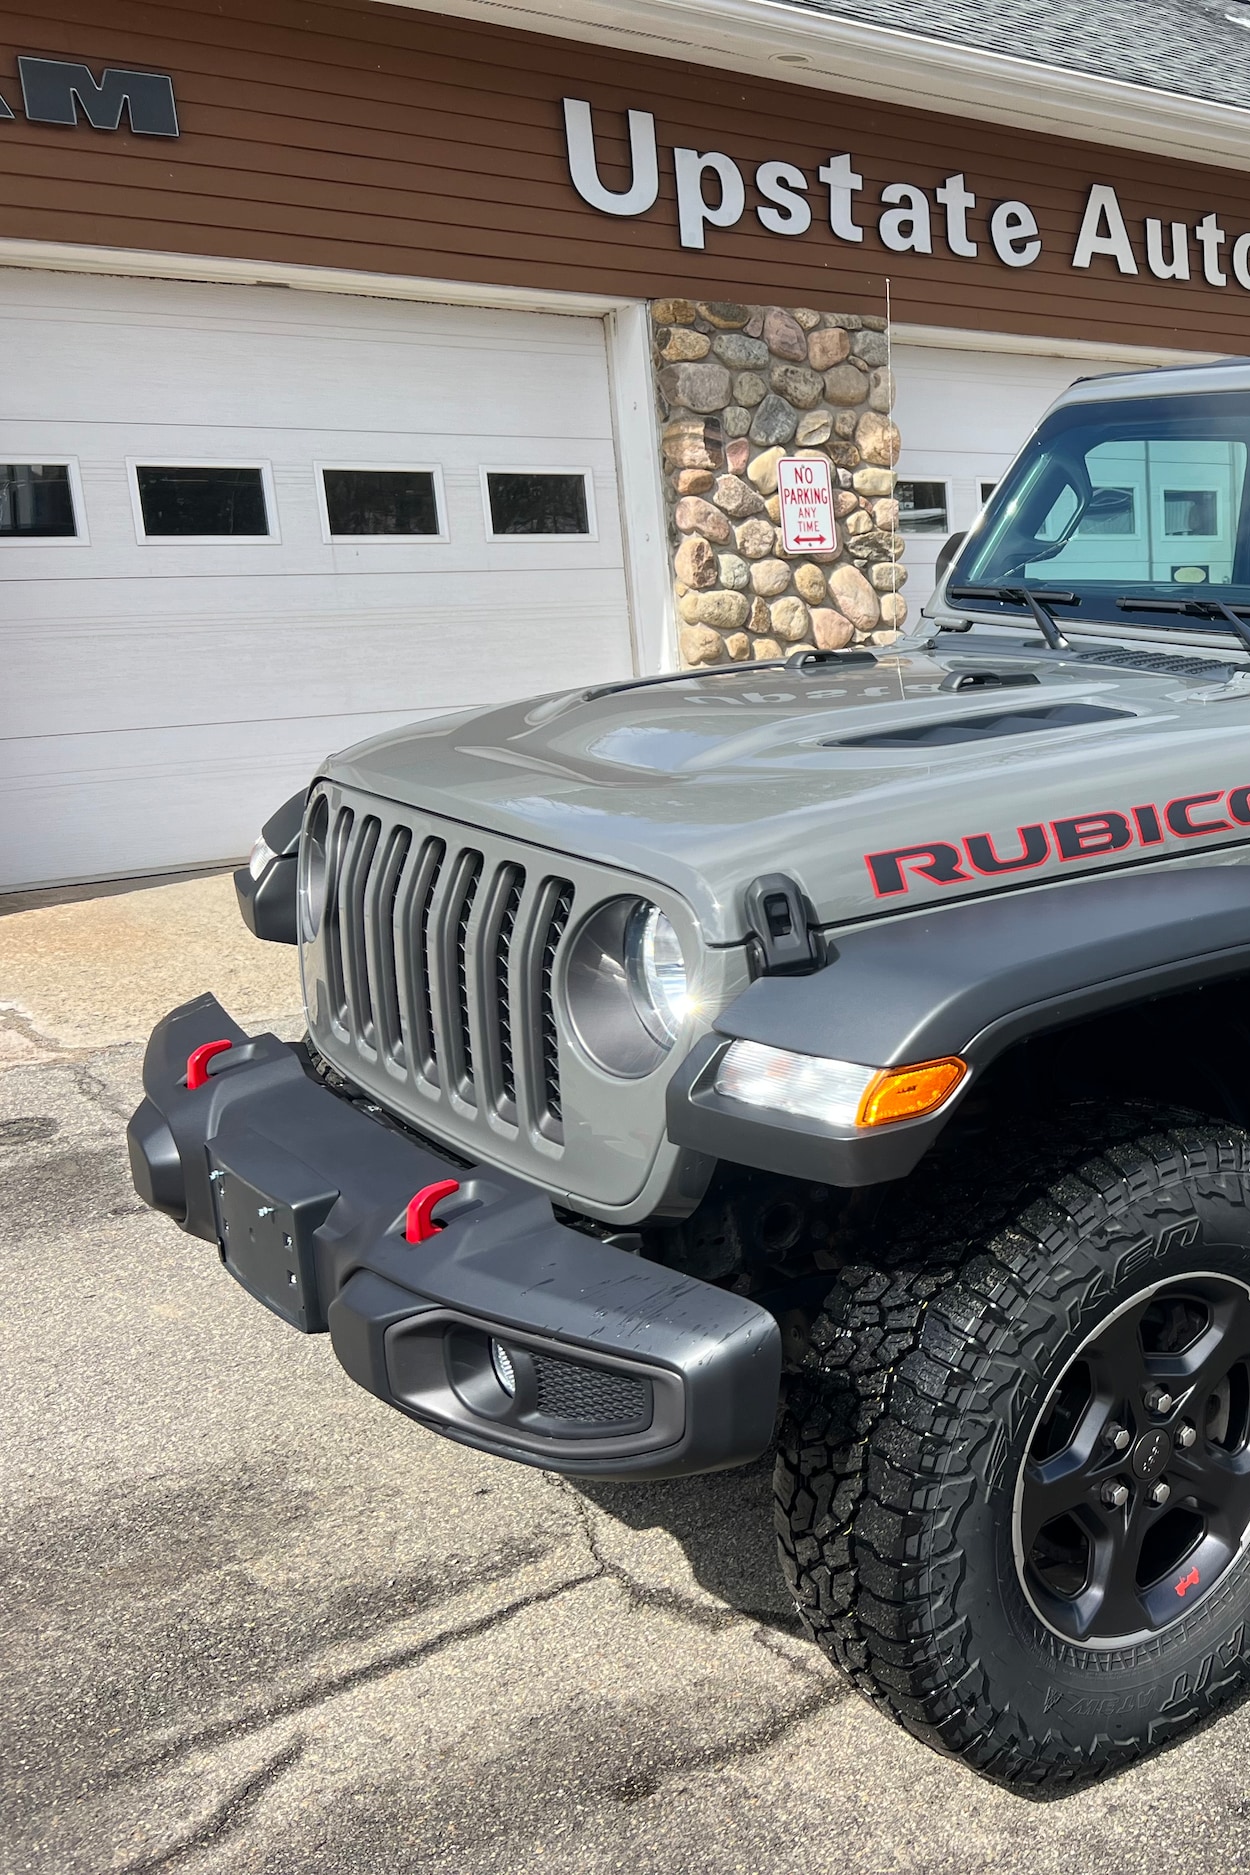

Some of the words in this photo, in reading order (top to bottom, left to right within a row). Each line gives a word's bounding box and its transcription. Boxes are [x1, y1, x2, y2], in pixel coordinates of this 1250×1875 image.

[562, 97, 1042, 268] Upstate
[794, 467, 813, 484] NO
[784, 488, 828, 505] PARKING
[798, 507, 817, 519] ANY
[798, 521, 820, 533] TIME
